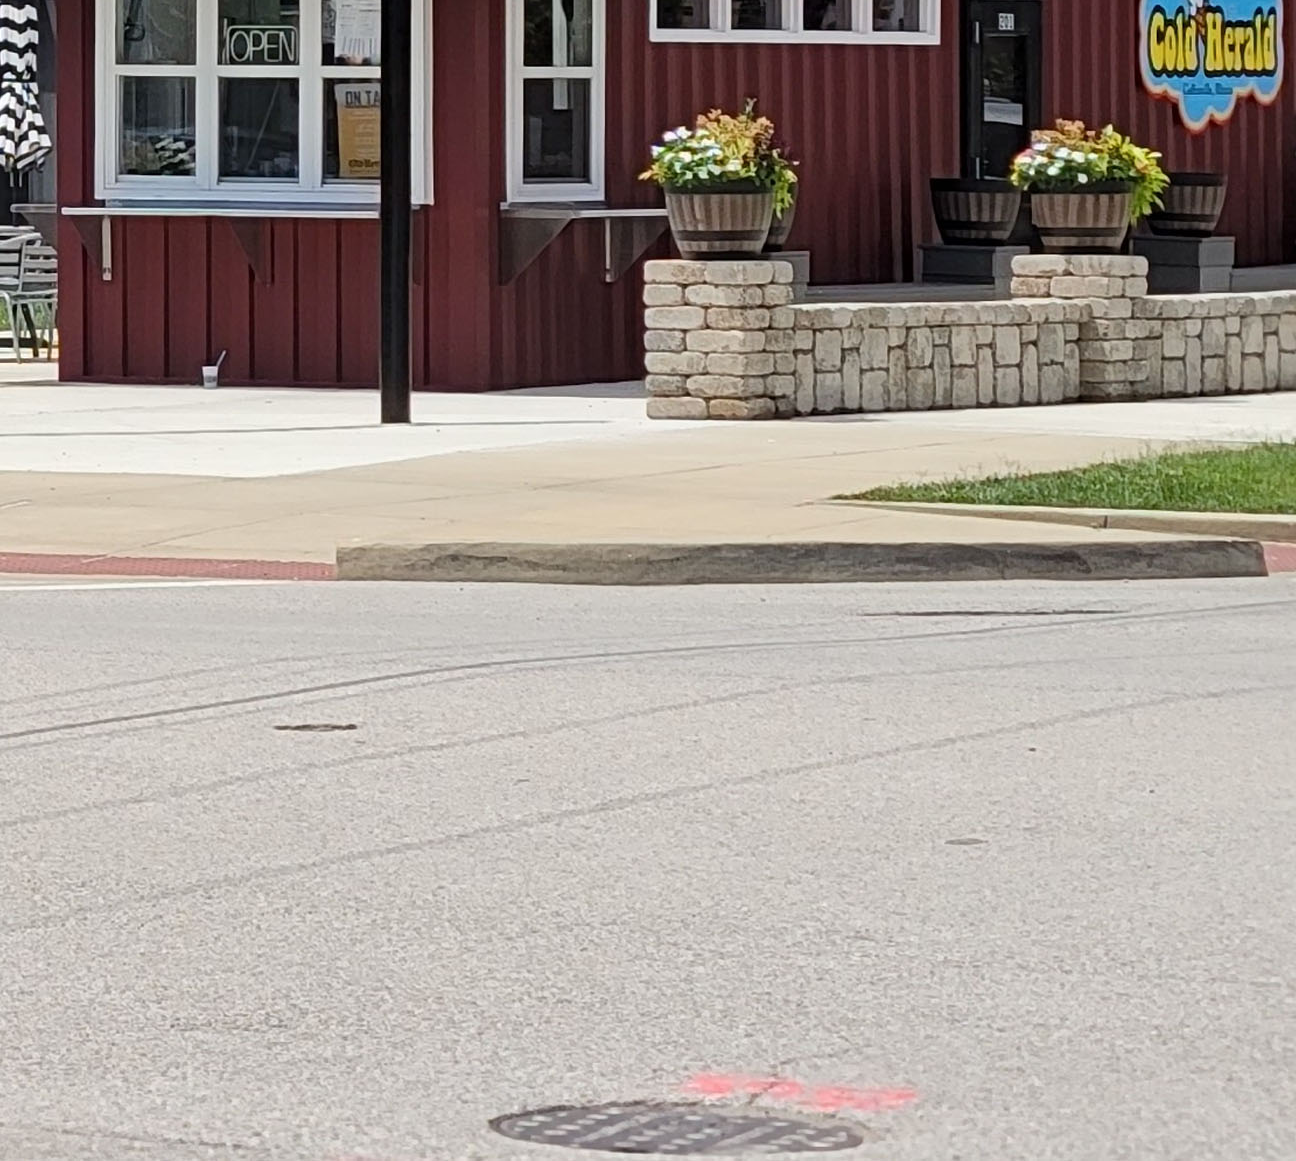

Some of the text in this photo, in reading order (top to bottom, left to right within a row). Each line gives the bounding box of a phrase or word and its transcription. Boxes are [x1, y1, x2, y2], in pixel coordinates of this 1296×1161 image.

[230, 30, 295, 63] OPEN
[1149, 7, 1277, 74] Cold Herald
[345, 91, 361, 106] ON
